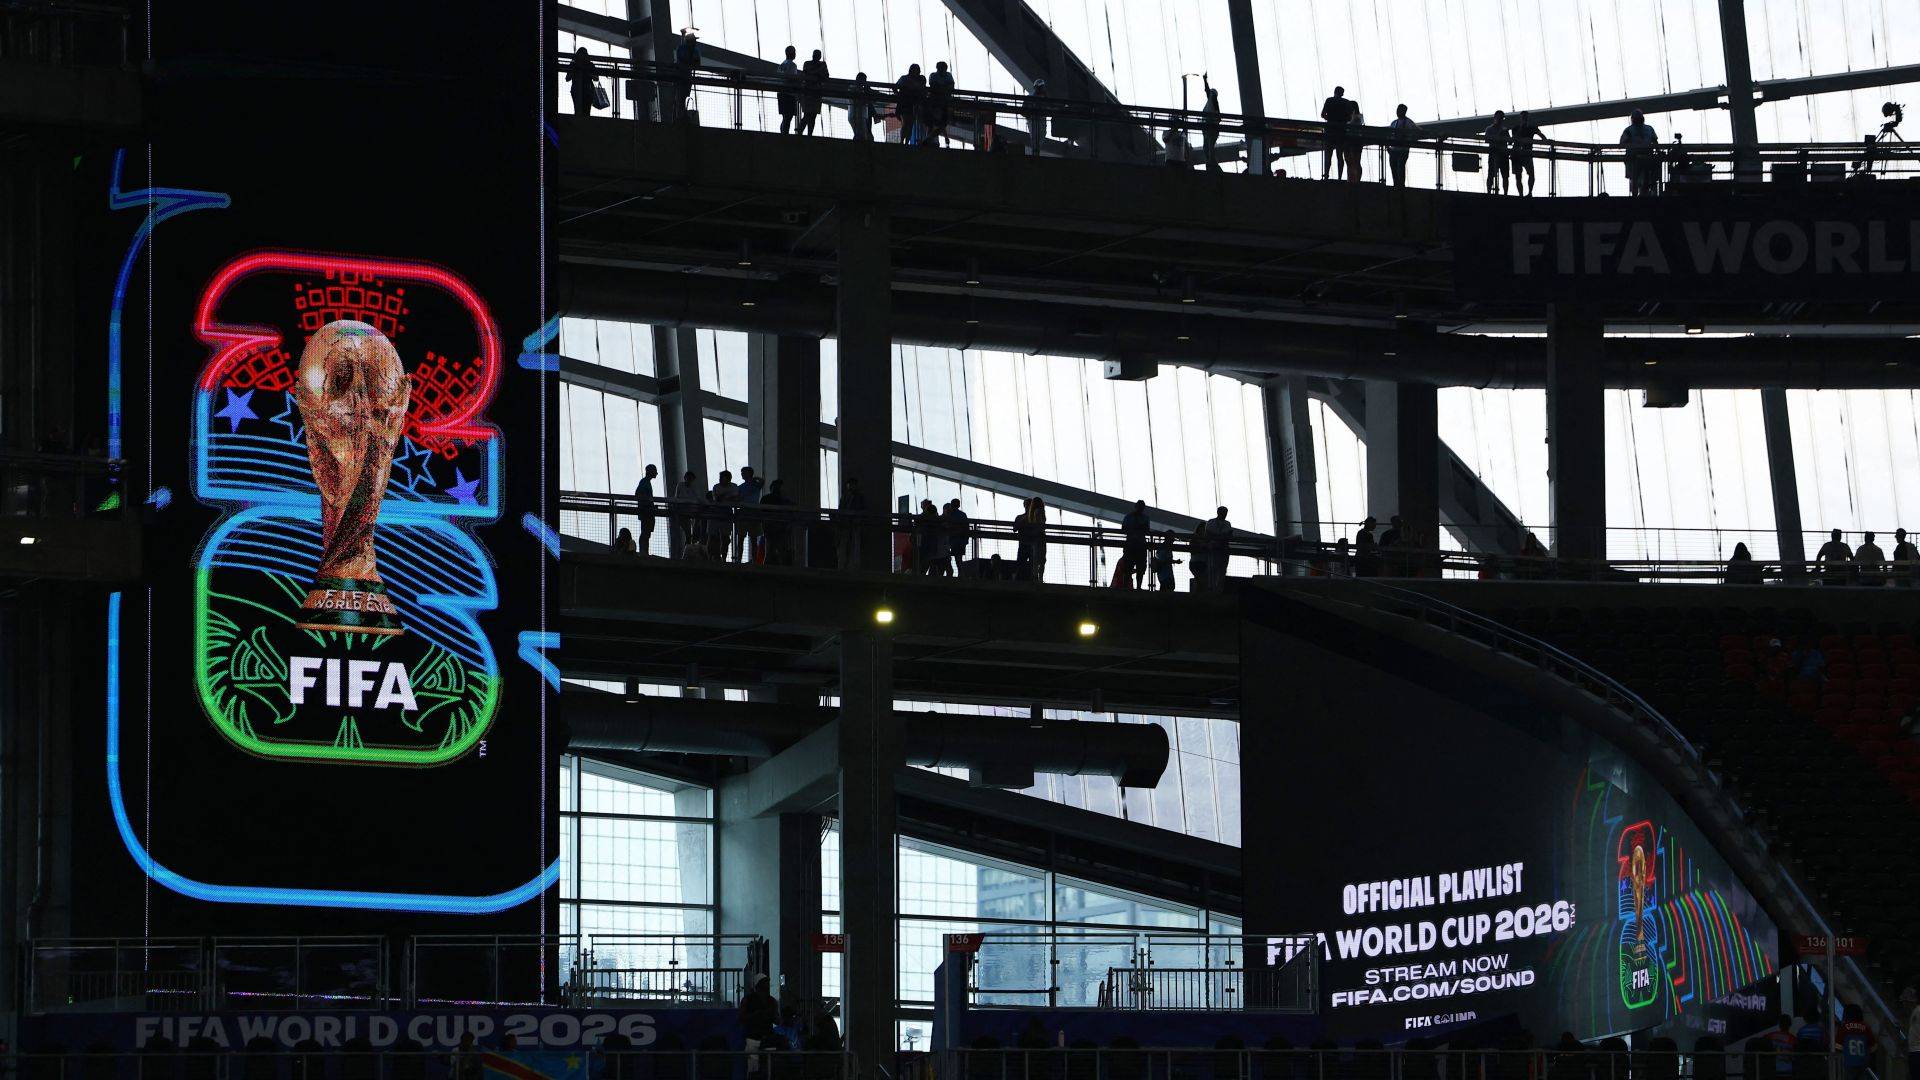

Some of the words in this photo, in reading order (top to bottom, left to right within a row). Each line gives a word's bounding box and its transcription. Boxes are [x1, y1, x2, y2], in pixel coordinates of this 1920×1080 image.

[1510, 220, 1672, 275] FIFA
[1681, 219, 1920, 275] WORL
[314, 599, 362, 610] WORLD
[366, 600, 391, 612] CUP
[326, 589, 378, 601] FIFA
[289, 655, 419, 711] FIFA
[1342, 875, 1435, 915] OFFICIAL
[1438, 862, 1524, 904] PLAYLIST
[823, 934, 844, 945] 135
[949, 934, 969, 945] 136
[1336, 921, 1437, 959] WORLD
[1441, 913, 1491, 948] CUP
[1807, 936, 1826, 947] 136
[1836, 937, 1853, 948] 101
[1364, 959, 1457, 985] STREAM
[1462, 953, 1509, 974] NOW
[1632, 967, 1650, 990] FIFA
[1331, 969, 1535, 1008] FIFA.COM/SOUND
[135, 1016, 230, 1048] FIFA
[407, 1014, 495, 1047] CUP
[503, 1013, 657, 1047] 2026
[1405, 1015, 1432, 1030] FIFA
